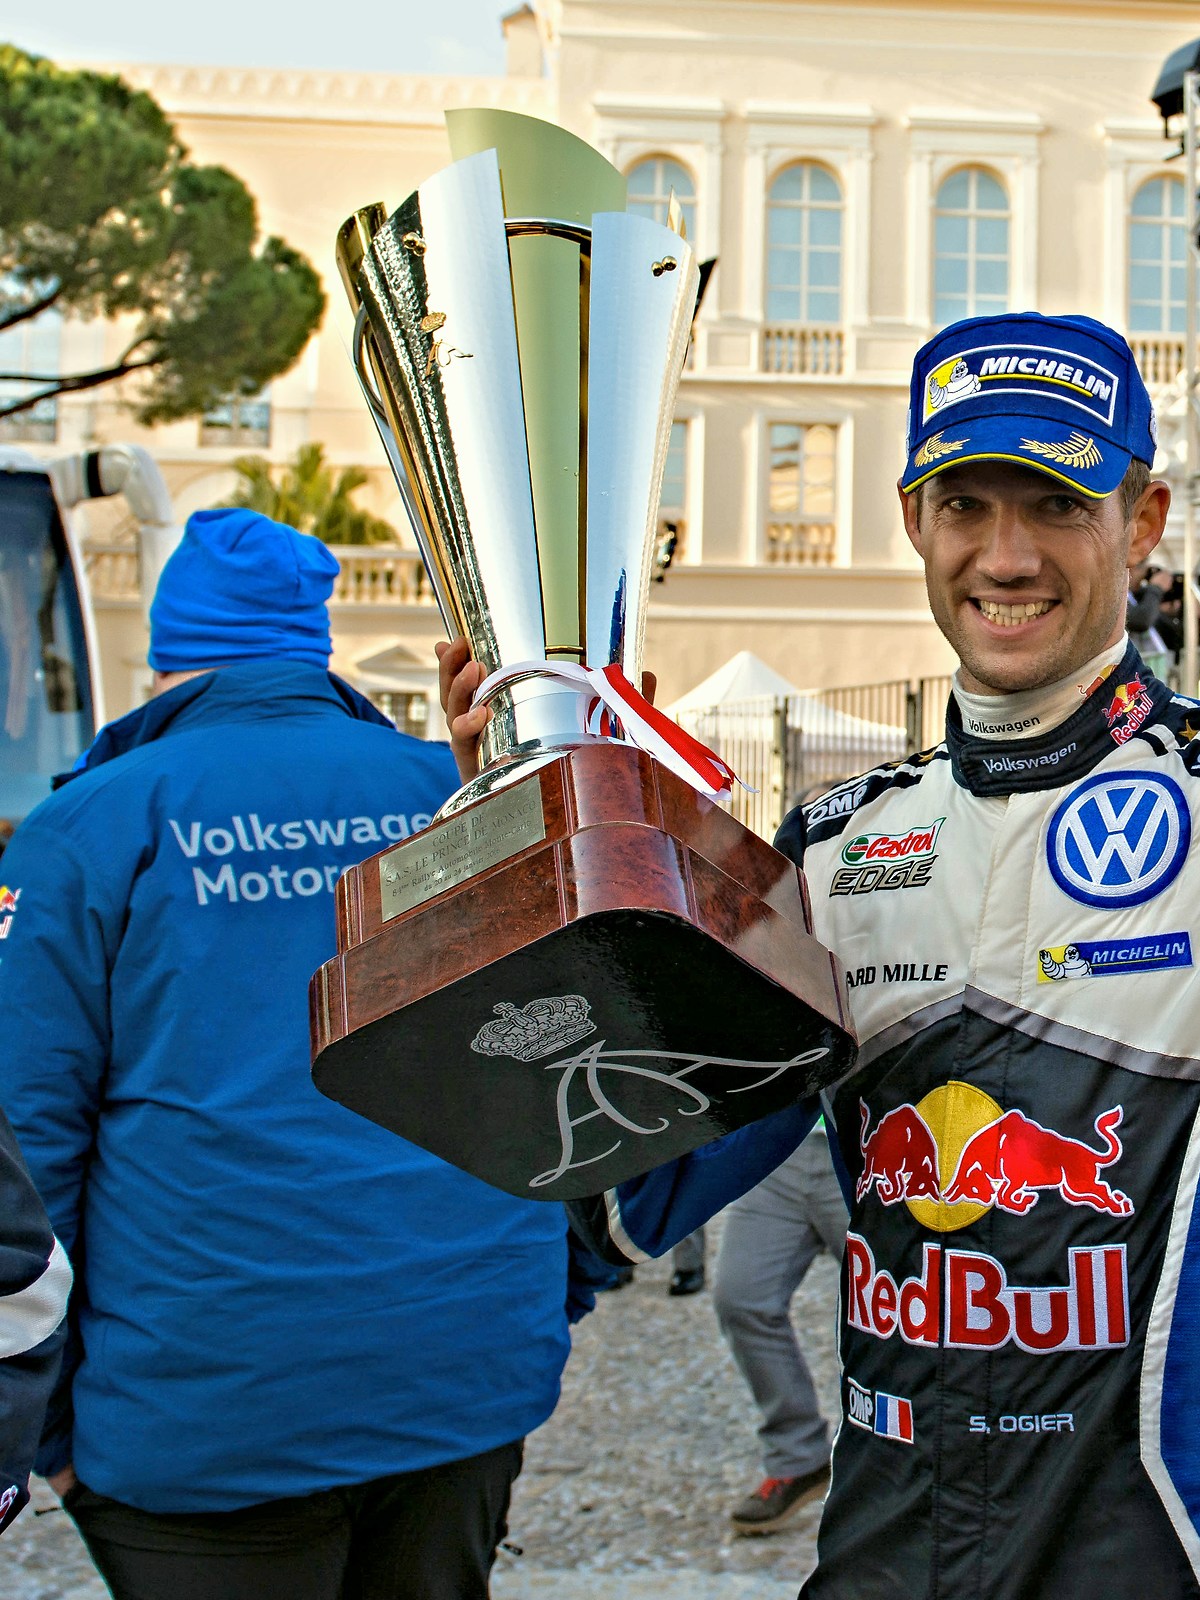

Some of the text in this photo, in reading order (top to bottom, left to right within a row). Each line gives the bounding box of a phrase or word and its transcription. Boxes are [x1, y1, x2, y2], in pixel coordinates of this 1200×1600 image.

[980, 356, 1111, 401] MICHELIN
[968, 715, 1041, 735] Volkswagen
[983, 742, 1077, 774] Volkswagen
[807, 784, 868, 825] OMP
[169, 813, 433, 858] Volkswage
[415, 857, 428, 871] LE
[432, 835, 469, 862] PRINCE
[474, 828, 488, 840] DE
[492, 800, 536, 829] MONACO
[433, 812, 485, 847] COUPE DE
[866, 825, 937, 860] Castrol
[192, 863, 355, 906] Motor
[412, 871, 435, 887] Rallye
[438, 846, 482, 873] Automobile
[829, 855, 939, 897] EDGE
[1091, 942, 1186, 964] MICHELIN
[882, 964, 949, 983] MILLE
[849, 1386, 874, 1424] OMP
[999, 1413, 1075, 1434] OGIER
